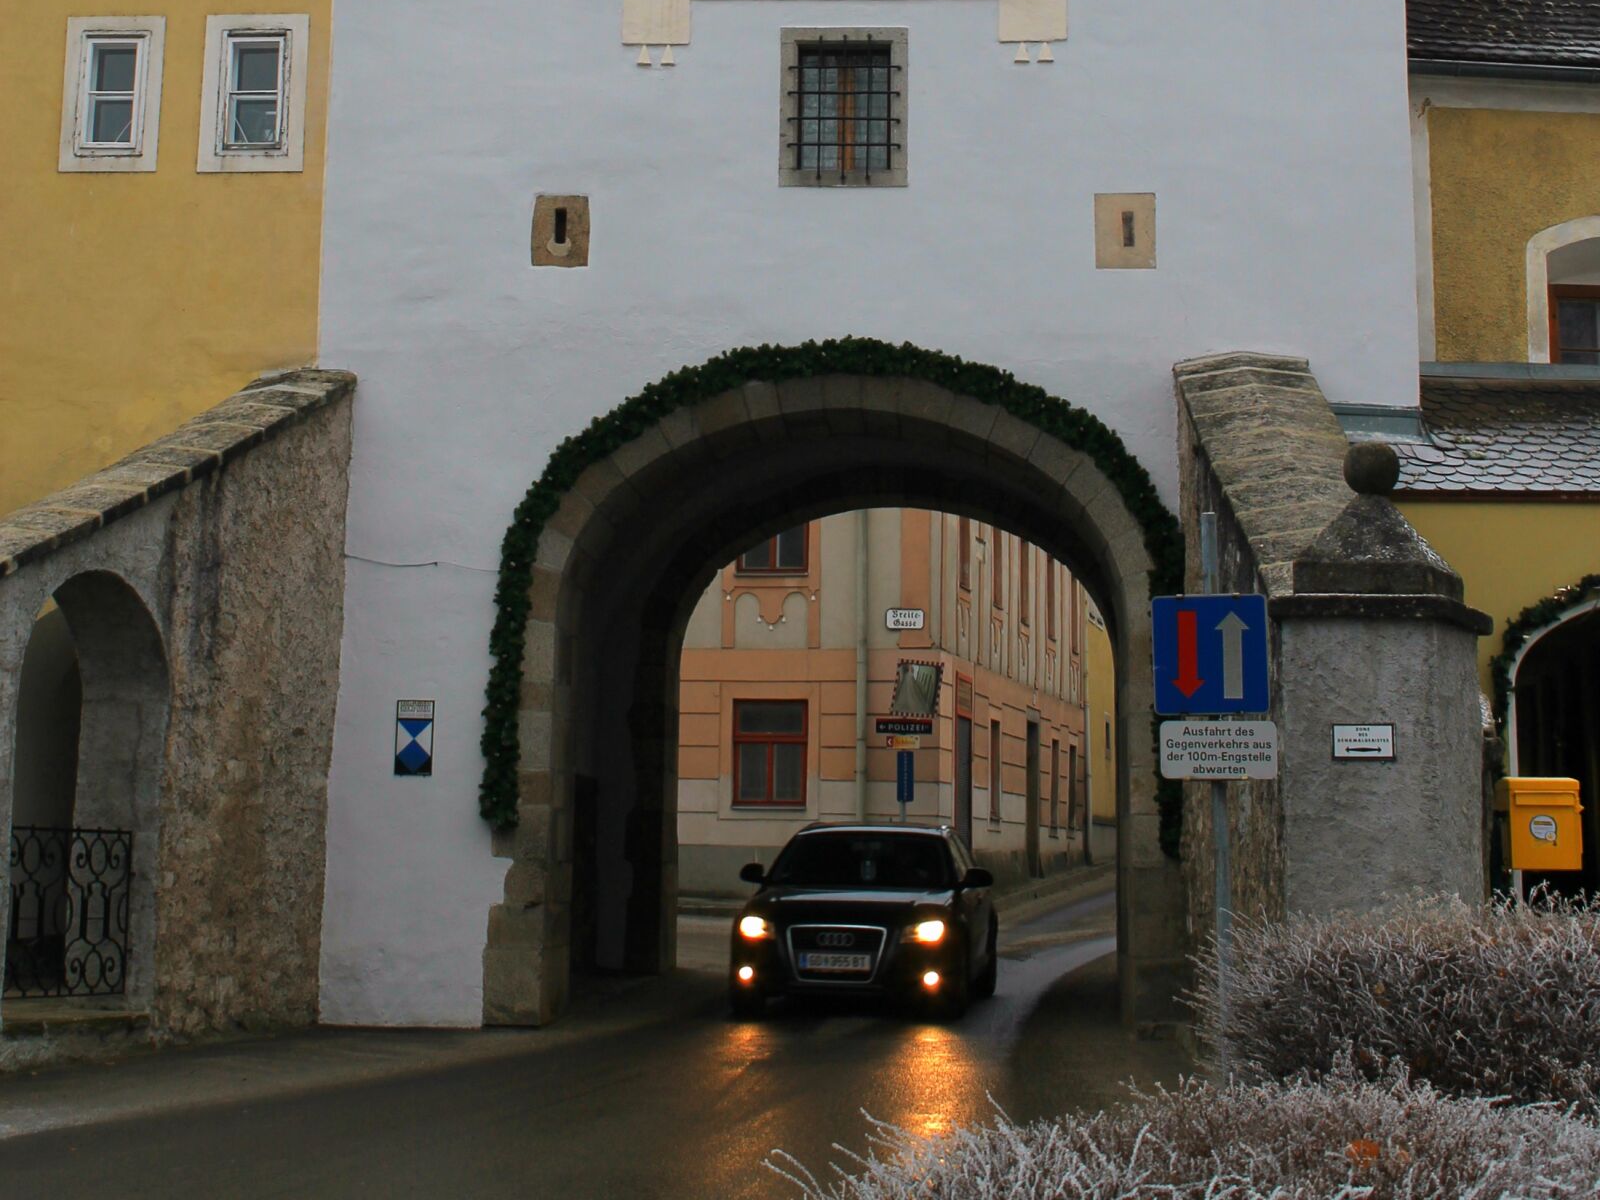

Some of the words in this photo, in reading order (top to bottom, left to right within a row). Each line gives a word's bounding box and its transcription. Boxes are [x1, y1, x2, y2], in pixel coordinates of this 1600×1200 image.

[1183, 726, 1231, 736] Ausfahrt
[1235, 727, 1255, 737] des
[1166, 739, 1249, 750] Gegenverkehrs
[1253, 740, 1272, 749] aus
[1167, 752, 1185, 761] der
[1188, 752, 1272, 763] 100m-Engstelle
[1193, 765, 1246, 774] abwarten
